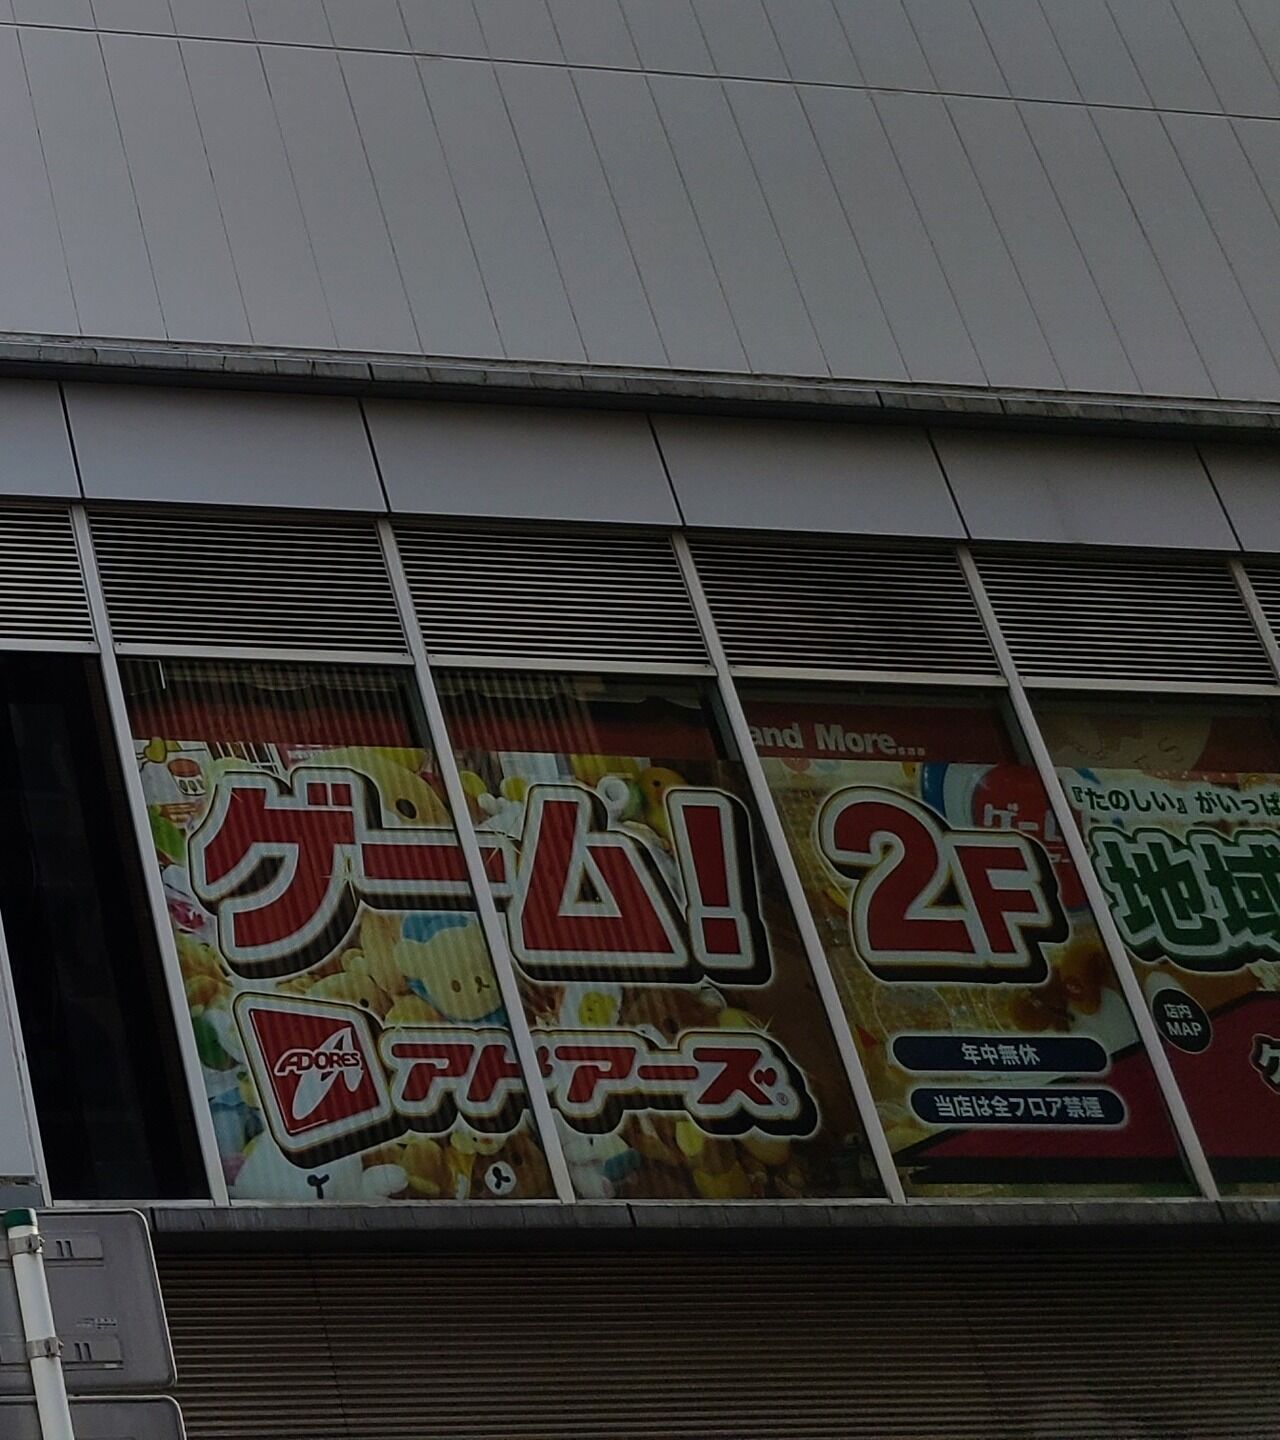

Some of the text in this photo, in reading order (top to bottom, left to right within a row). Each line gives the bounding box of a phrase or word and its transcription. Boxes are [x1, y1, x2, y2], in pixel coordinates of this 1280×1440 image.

[749, 721, 926, 757] and More...
[833, 800, 1040, 956] 2F
[1165, 1020, 1203, 1037] MAP
[274, 1047, 362, 1077] ADORES
[960, 1041, 1043, 1066] 年中無休
[390, 1042, 778, 1106] アドアーズ
[932, 1094, 1106, 1120] 当店は全フロア禁煙
